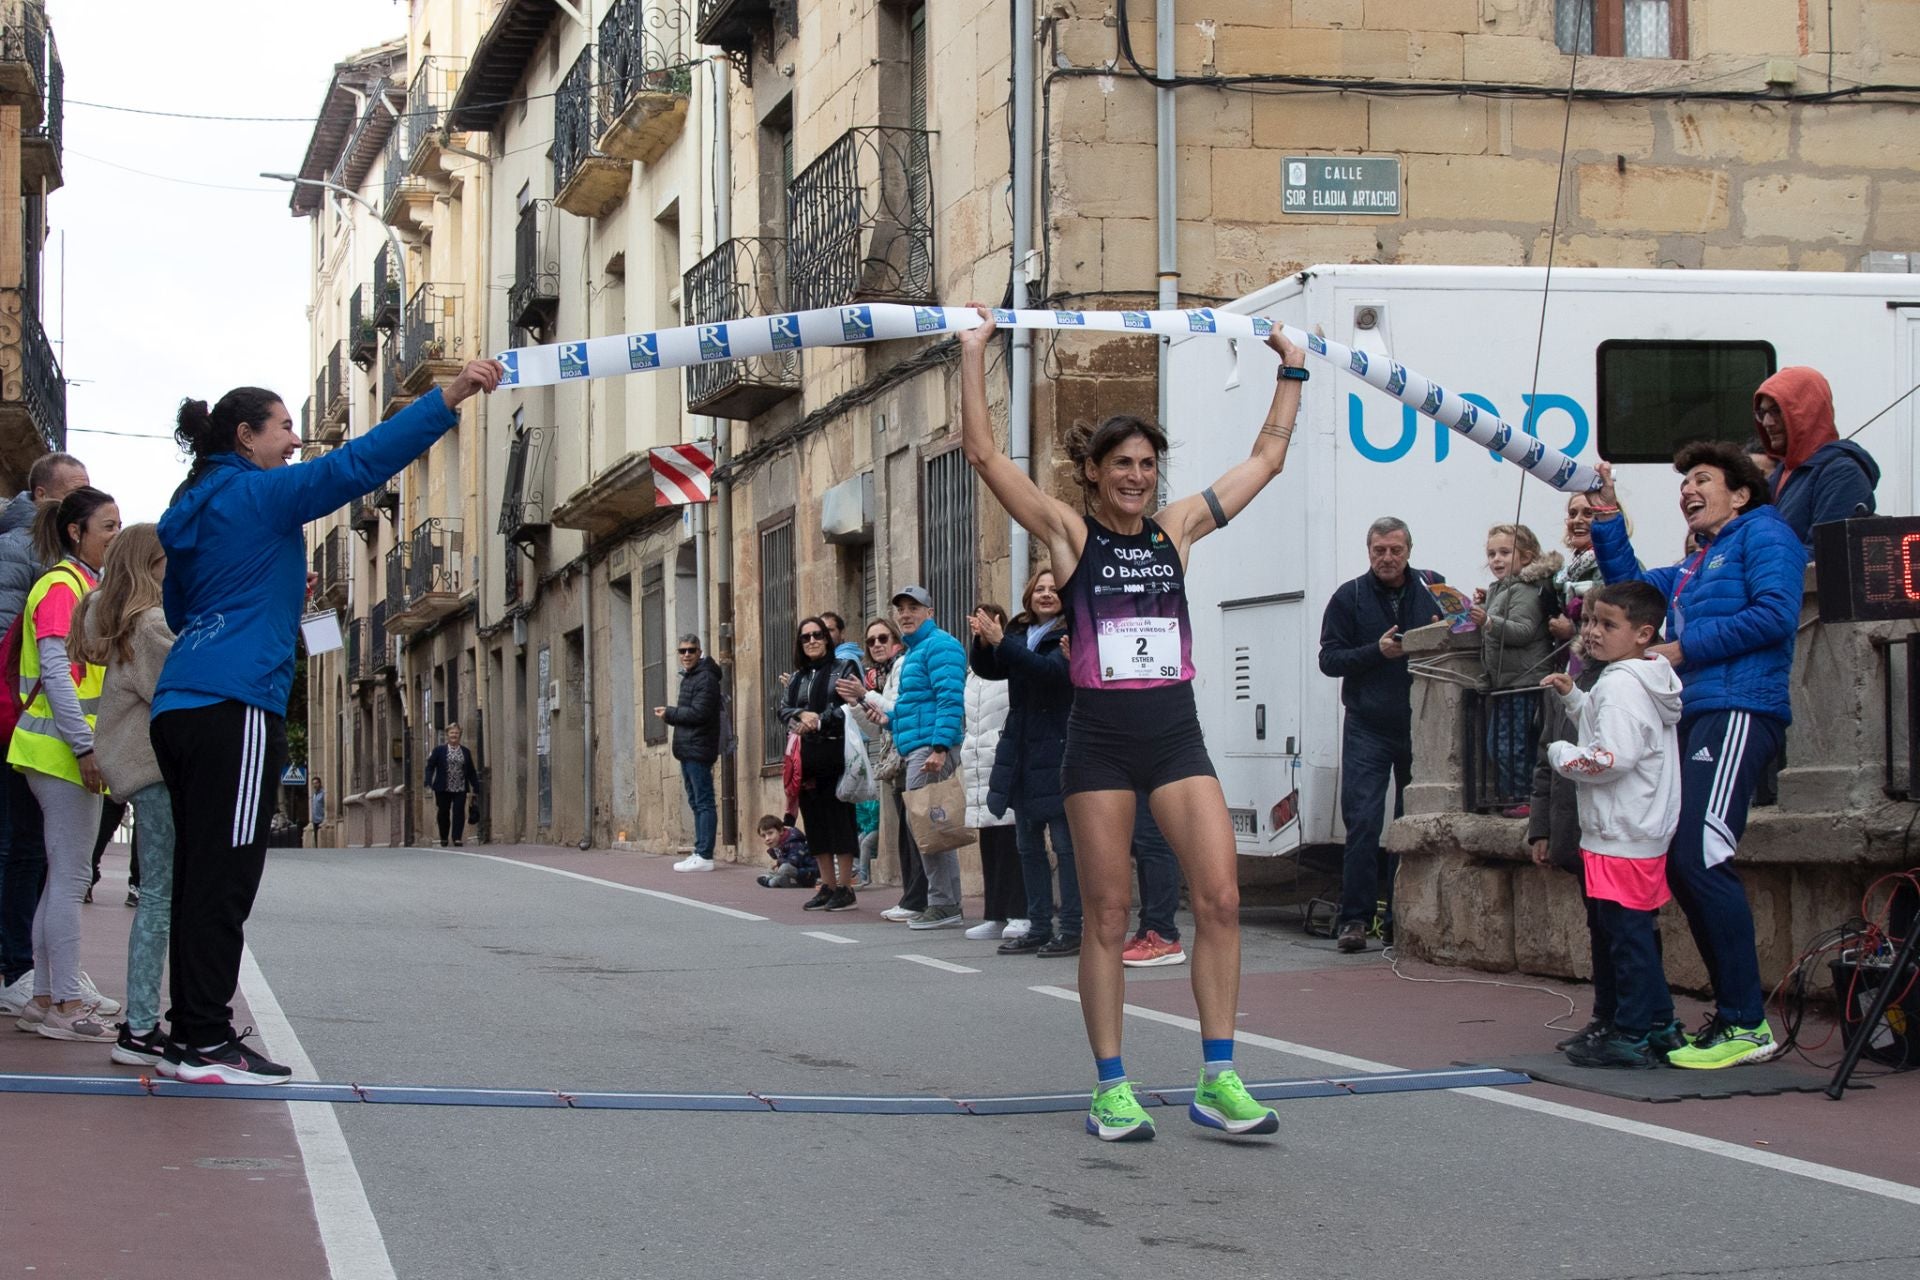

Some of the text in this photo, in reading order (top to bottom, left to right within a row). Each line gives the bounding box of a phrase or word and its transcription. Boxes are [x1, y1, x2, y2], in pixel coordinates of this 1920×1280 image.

[1325, 167, 1363, 180] CALLE
[1286, 190, 1397, 207] SOR ELADIA ARTACHO
[842, 307, 872, 329] R
[771, 317, 799, 338] R
[919, 323, 940, 331] RIOJA
[630, 335, 657, 356] R
[700, 327, 728, 347] R
[560, 345, 587, 364] R
[632, 361, 653, 369] RIOJA
[562, 370, 583, 378] RIOJA
[1114, 548, 1153, 561] CUPA
[1102, 564, 1174, 578] O BARCO
[1136, 637, 1148, 655] 2
